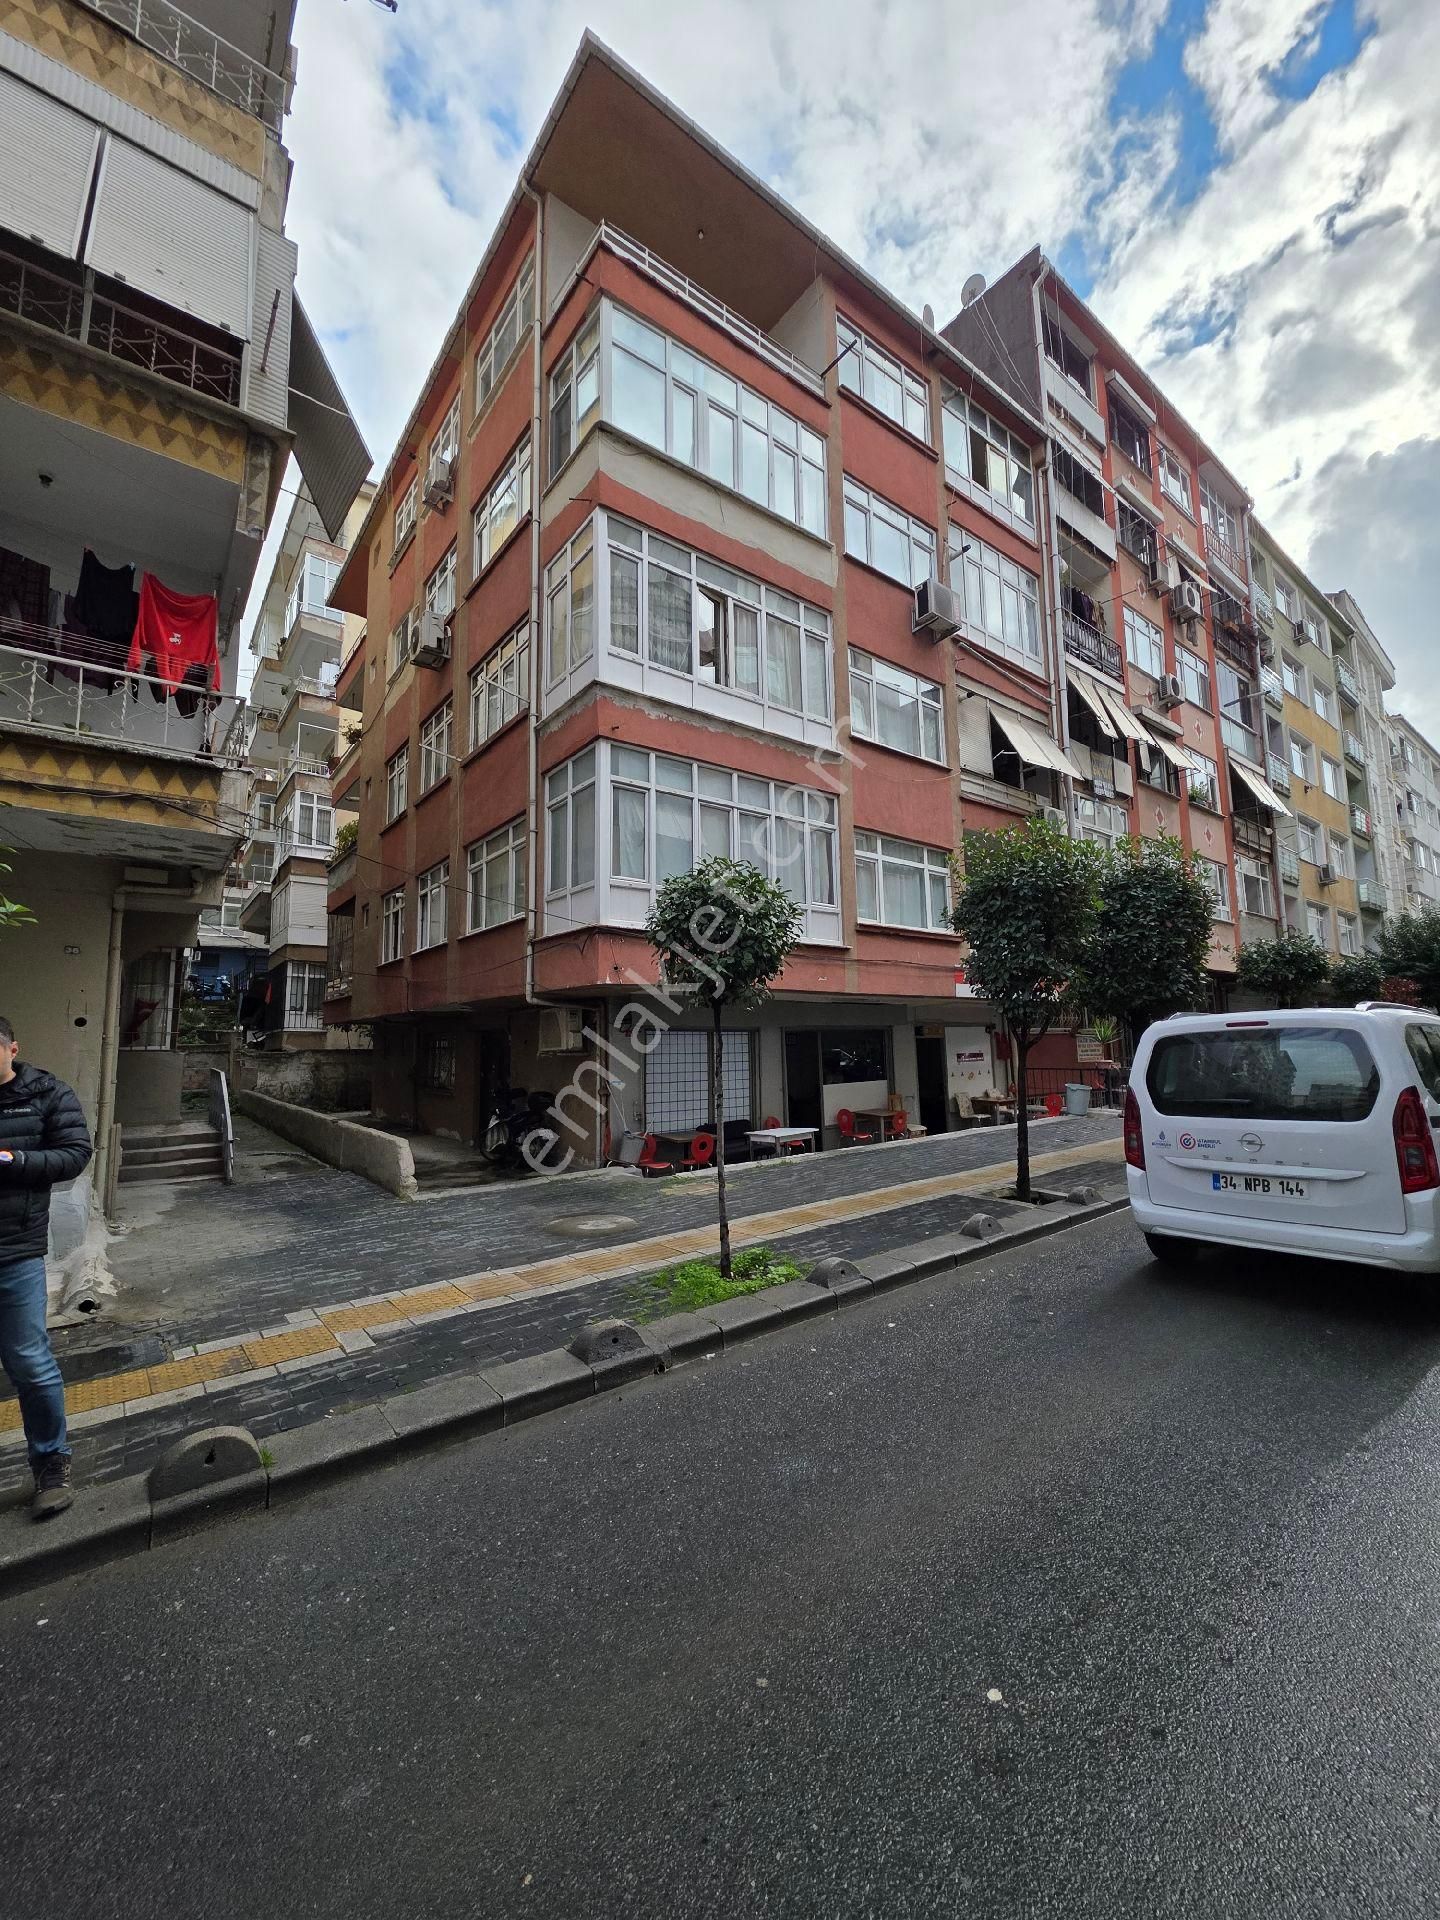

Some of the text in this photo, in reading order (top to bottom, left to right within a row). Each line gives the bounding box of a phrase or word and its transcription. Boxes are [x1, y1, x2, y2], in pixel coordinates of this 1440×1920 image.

[1221, 1175, 1237, 1190] 34
[1244, 1177, 1271, 1193] NPB
[1279, 1180, 1305, 1197] 144
